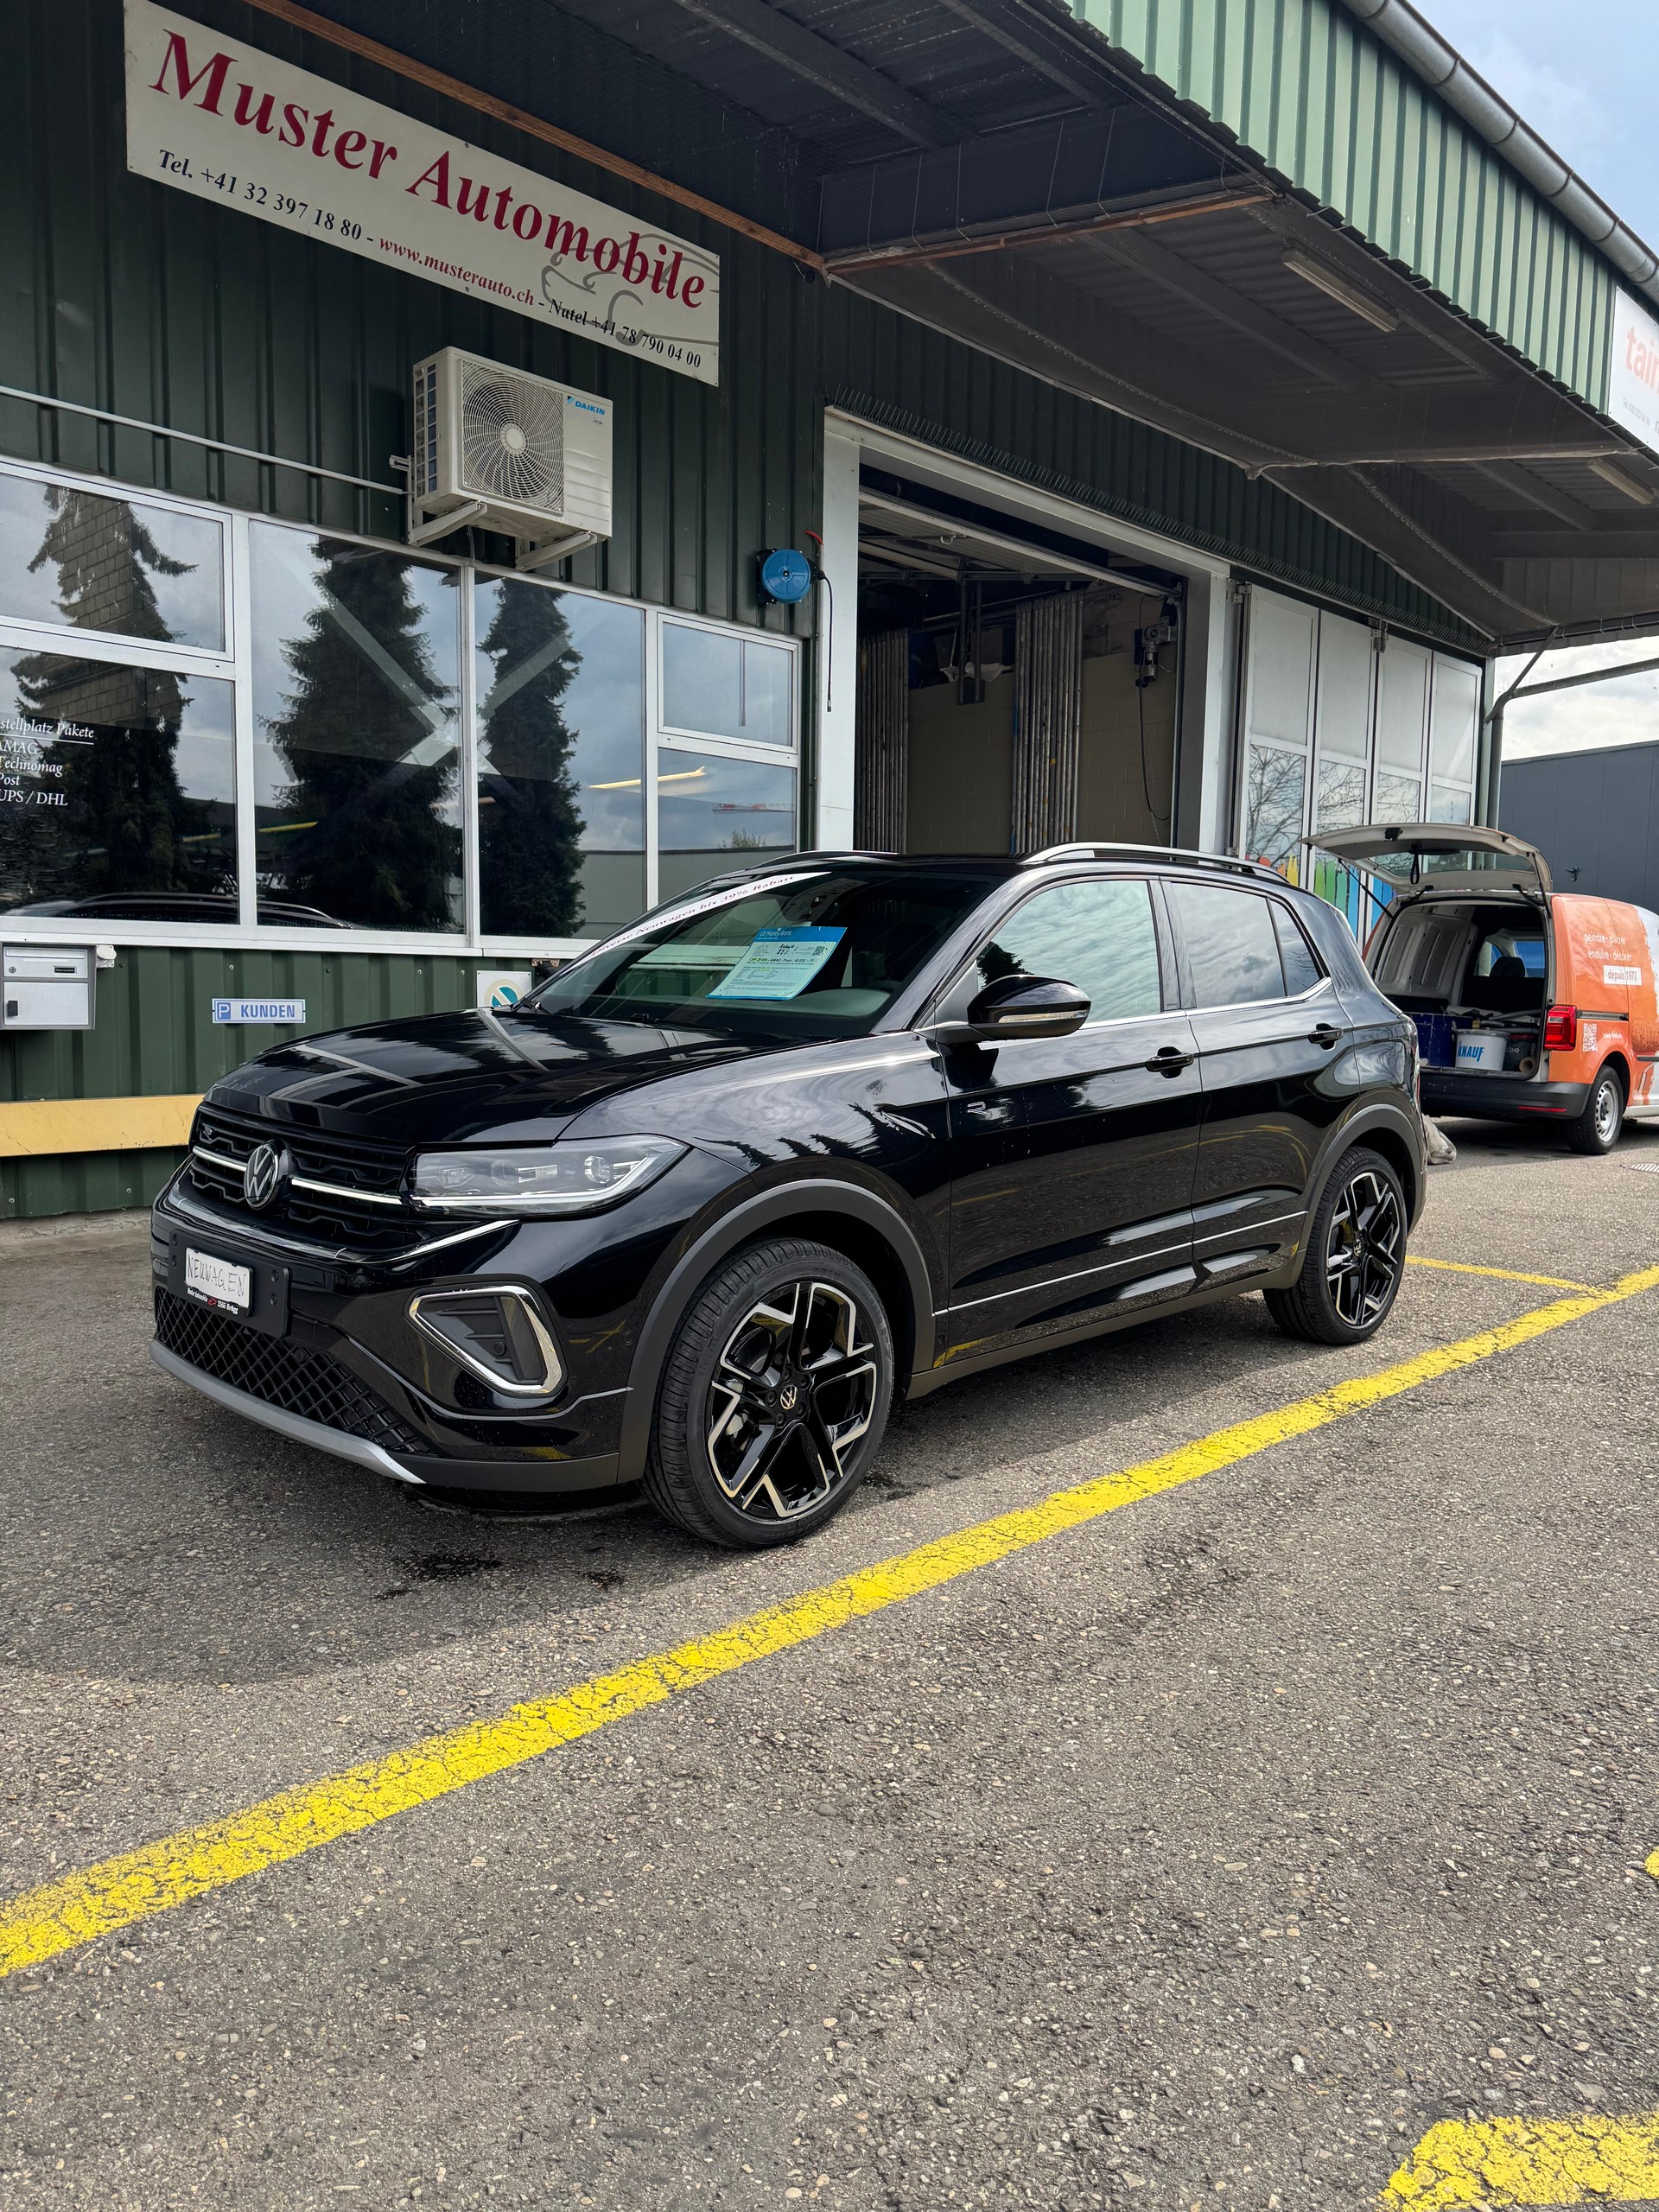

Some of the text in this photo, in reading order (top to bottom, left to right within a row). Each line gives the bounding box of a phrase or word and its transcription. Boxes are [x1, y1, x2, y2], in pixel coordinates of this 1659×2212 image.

[149, 29, 705, 308] Muster Automobile
[159, 149, 193, 179] Tel.
[200, 168, 237, 194] +41
[244, 182, 266, 205] 32
[273, 194, 308, 219] 397
[313, 209, 334, 231] 18
[340, 219, 362, 241] 80
[378, 237, 535, 307] www.musterauto.ch
[549, 297, 587, 327] Natel
[591, 315, 617, 338] +41
[621, 325, 638, 345] 78
[641, 333, 664, 355] 790
[668, 343, 682, 363] 04
[686, 350, 702, 369] 00
[575, 400, 606, 416] DAIKIN
[56, 722, 94, 738] Pakete
[0, 755, 63, 778] Technomag
[0, 789, 23, 803] UPS
[35, 791, 68, 805] DHL
[1607, 969, 1625, 982] depuis
[240, 1004, 296, 1018] KUNDEN
[1458, 1040, 1484, 1062] KNAUF
